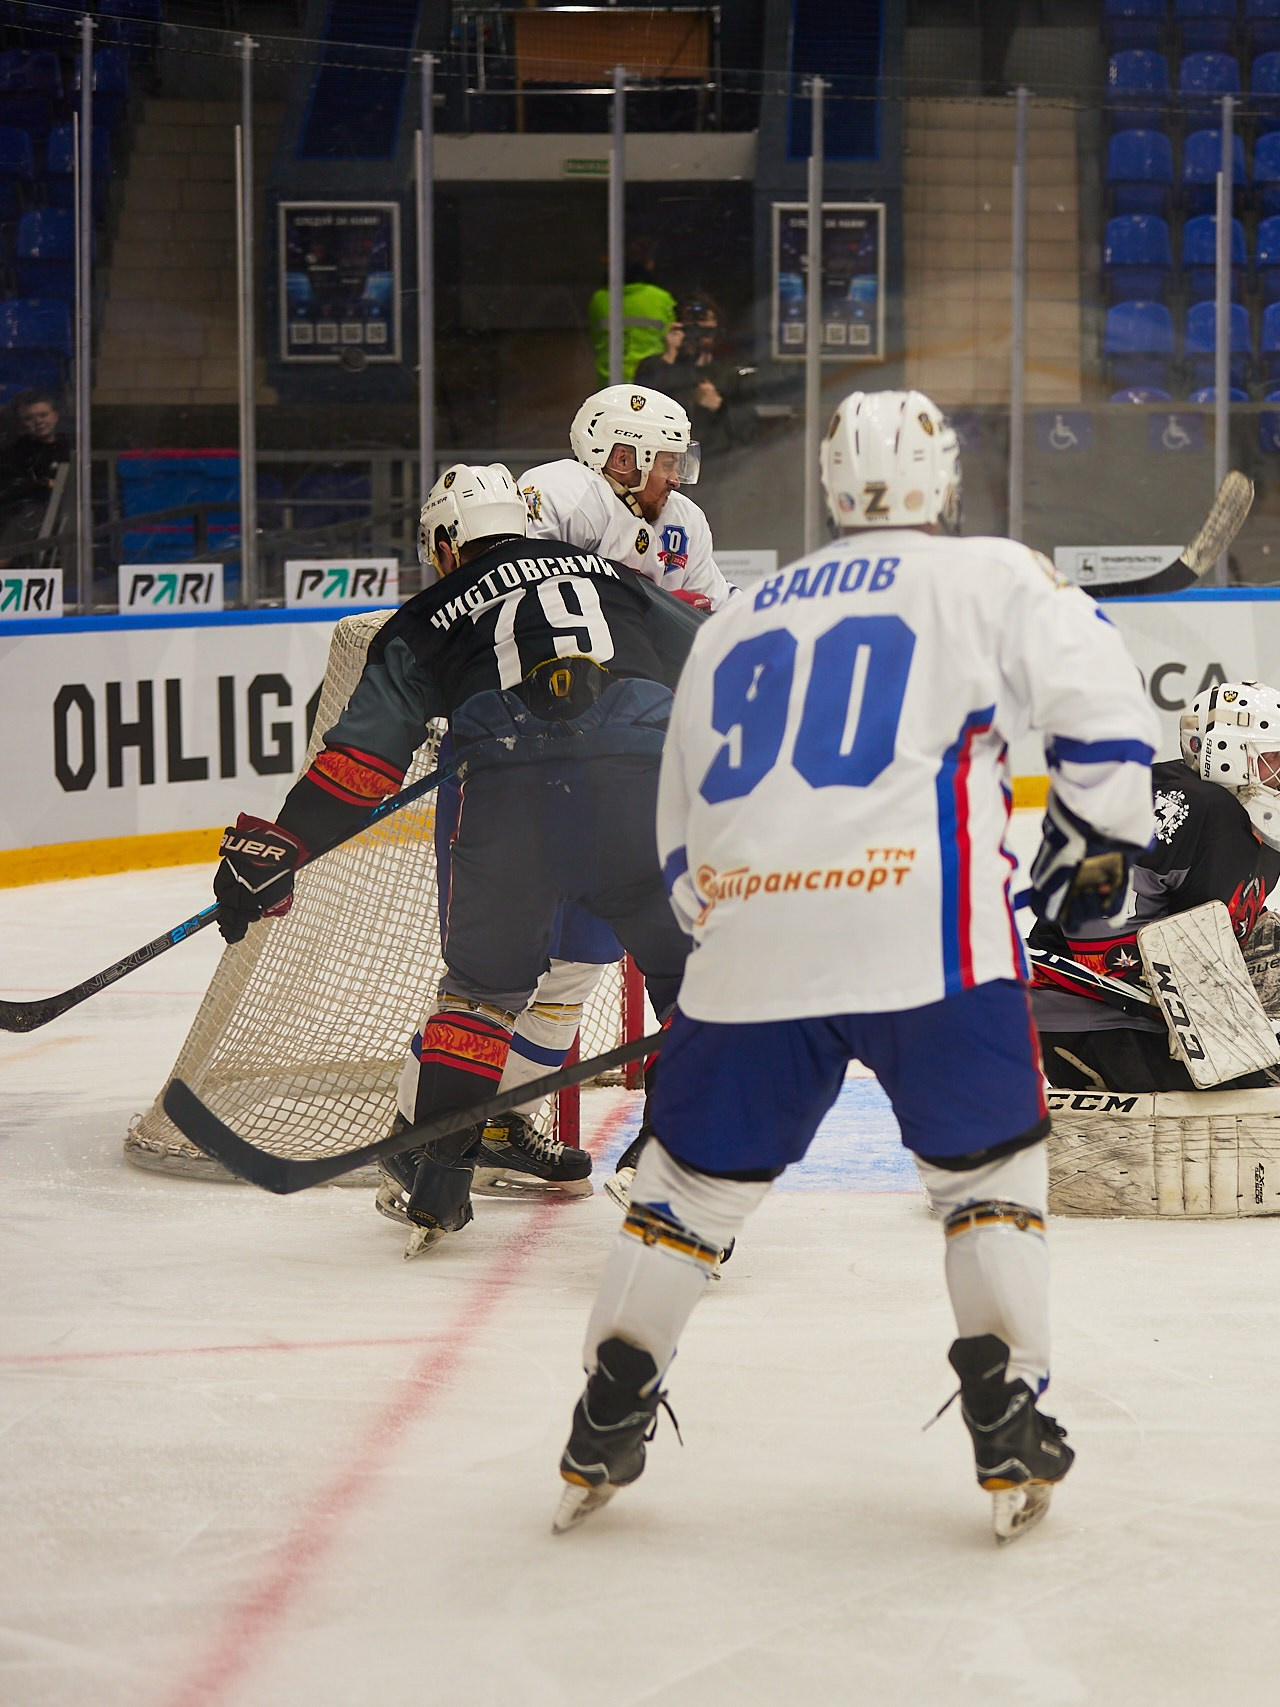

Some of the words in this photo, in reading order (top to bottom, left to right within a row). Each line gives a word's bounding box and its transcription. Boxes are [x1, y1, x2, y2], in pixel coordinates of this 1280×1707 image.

[614, 428, 643, 440] CCM
[0, 578, 55, 612] ARI
[129, 572, 215, 606] PARI
[297, 567, 389, 600] PARI
[753, 557, 901, 613] ВАЛОВ
[468, 574, 615, 691] 79
[698, 614, 917, 806] 90
[53, 673, 323, 792] OHLIG
[1203, 737, 1214, 779] BAUER
[866, 848, 916, 863] ТТМ
[1152, 960, 1207, 1063] CCM
[1047, 1093, 1139, 1113] CCM
